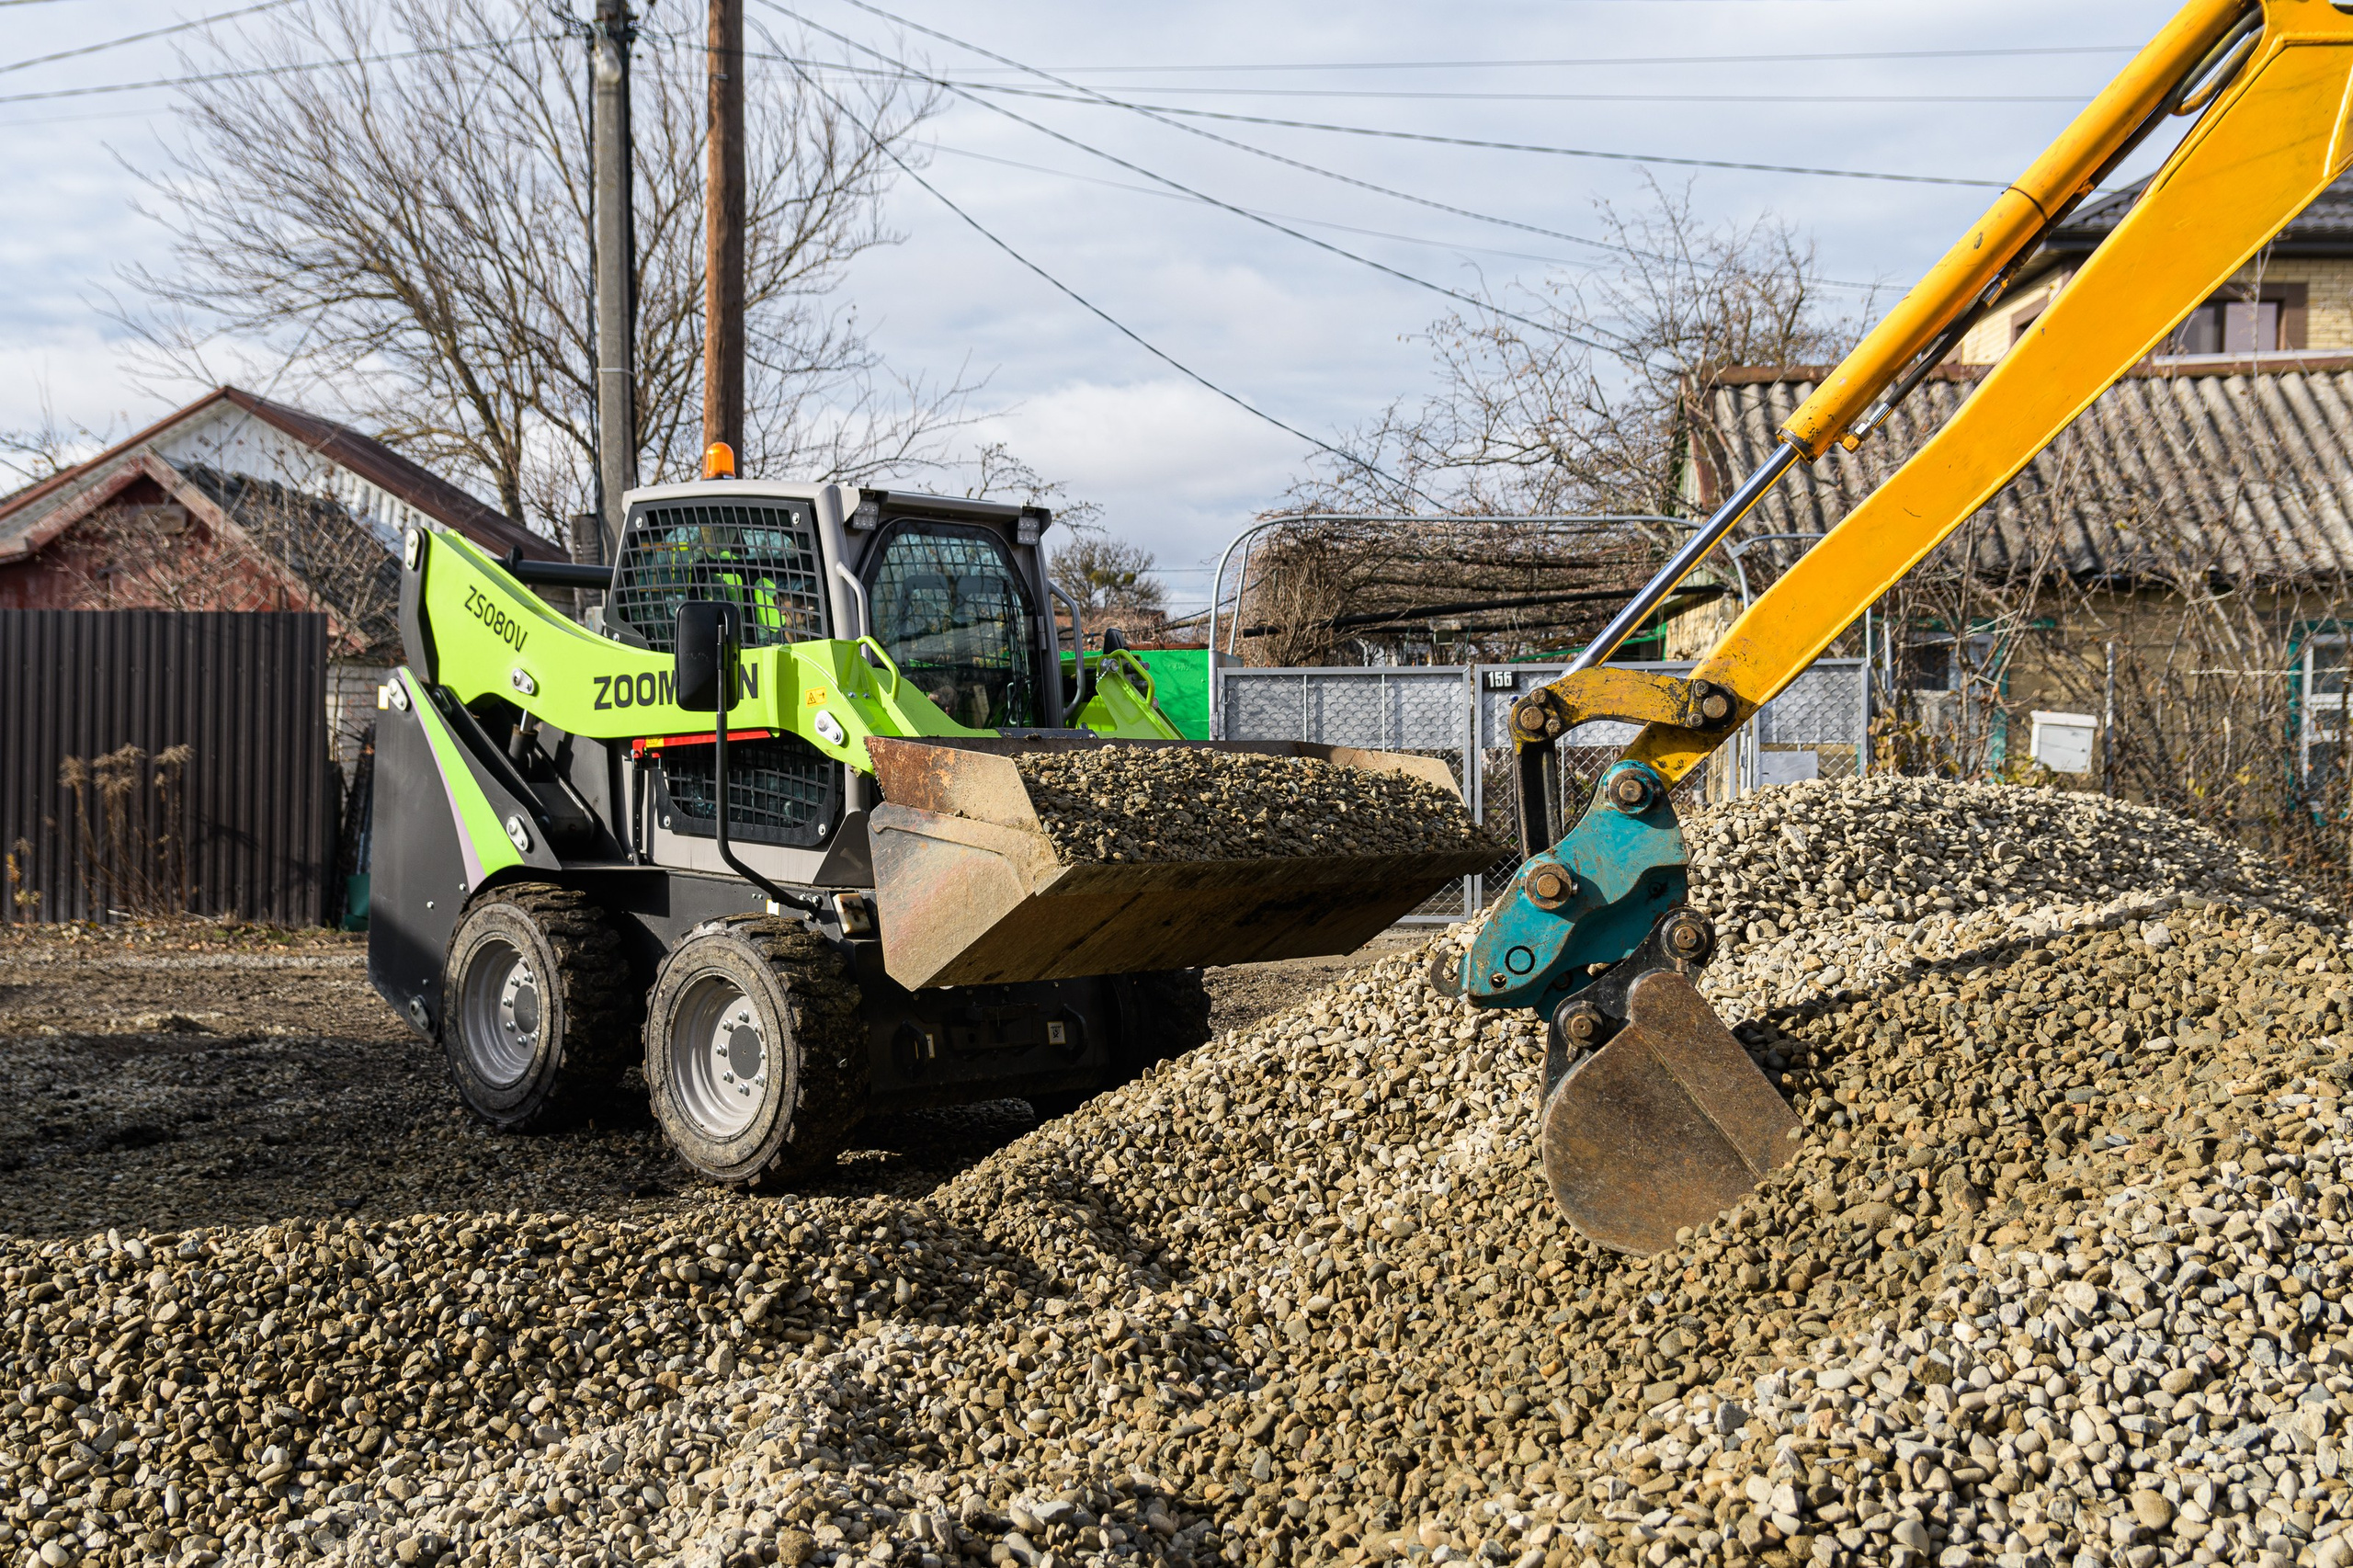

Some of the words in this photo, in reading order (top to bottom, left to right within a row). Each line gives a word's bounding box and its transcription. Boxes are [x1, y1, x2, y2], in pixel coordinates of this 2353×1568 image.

[464, 585, 529, 653] ZS080V
[593, 662, 758, 710] ZOOMN
[1488, 671, 1513, 688] 156
